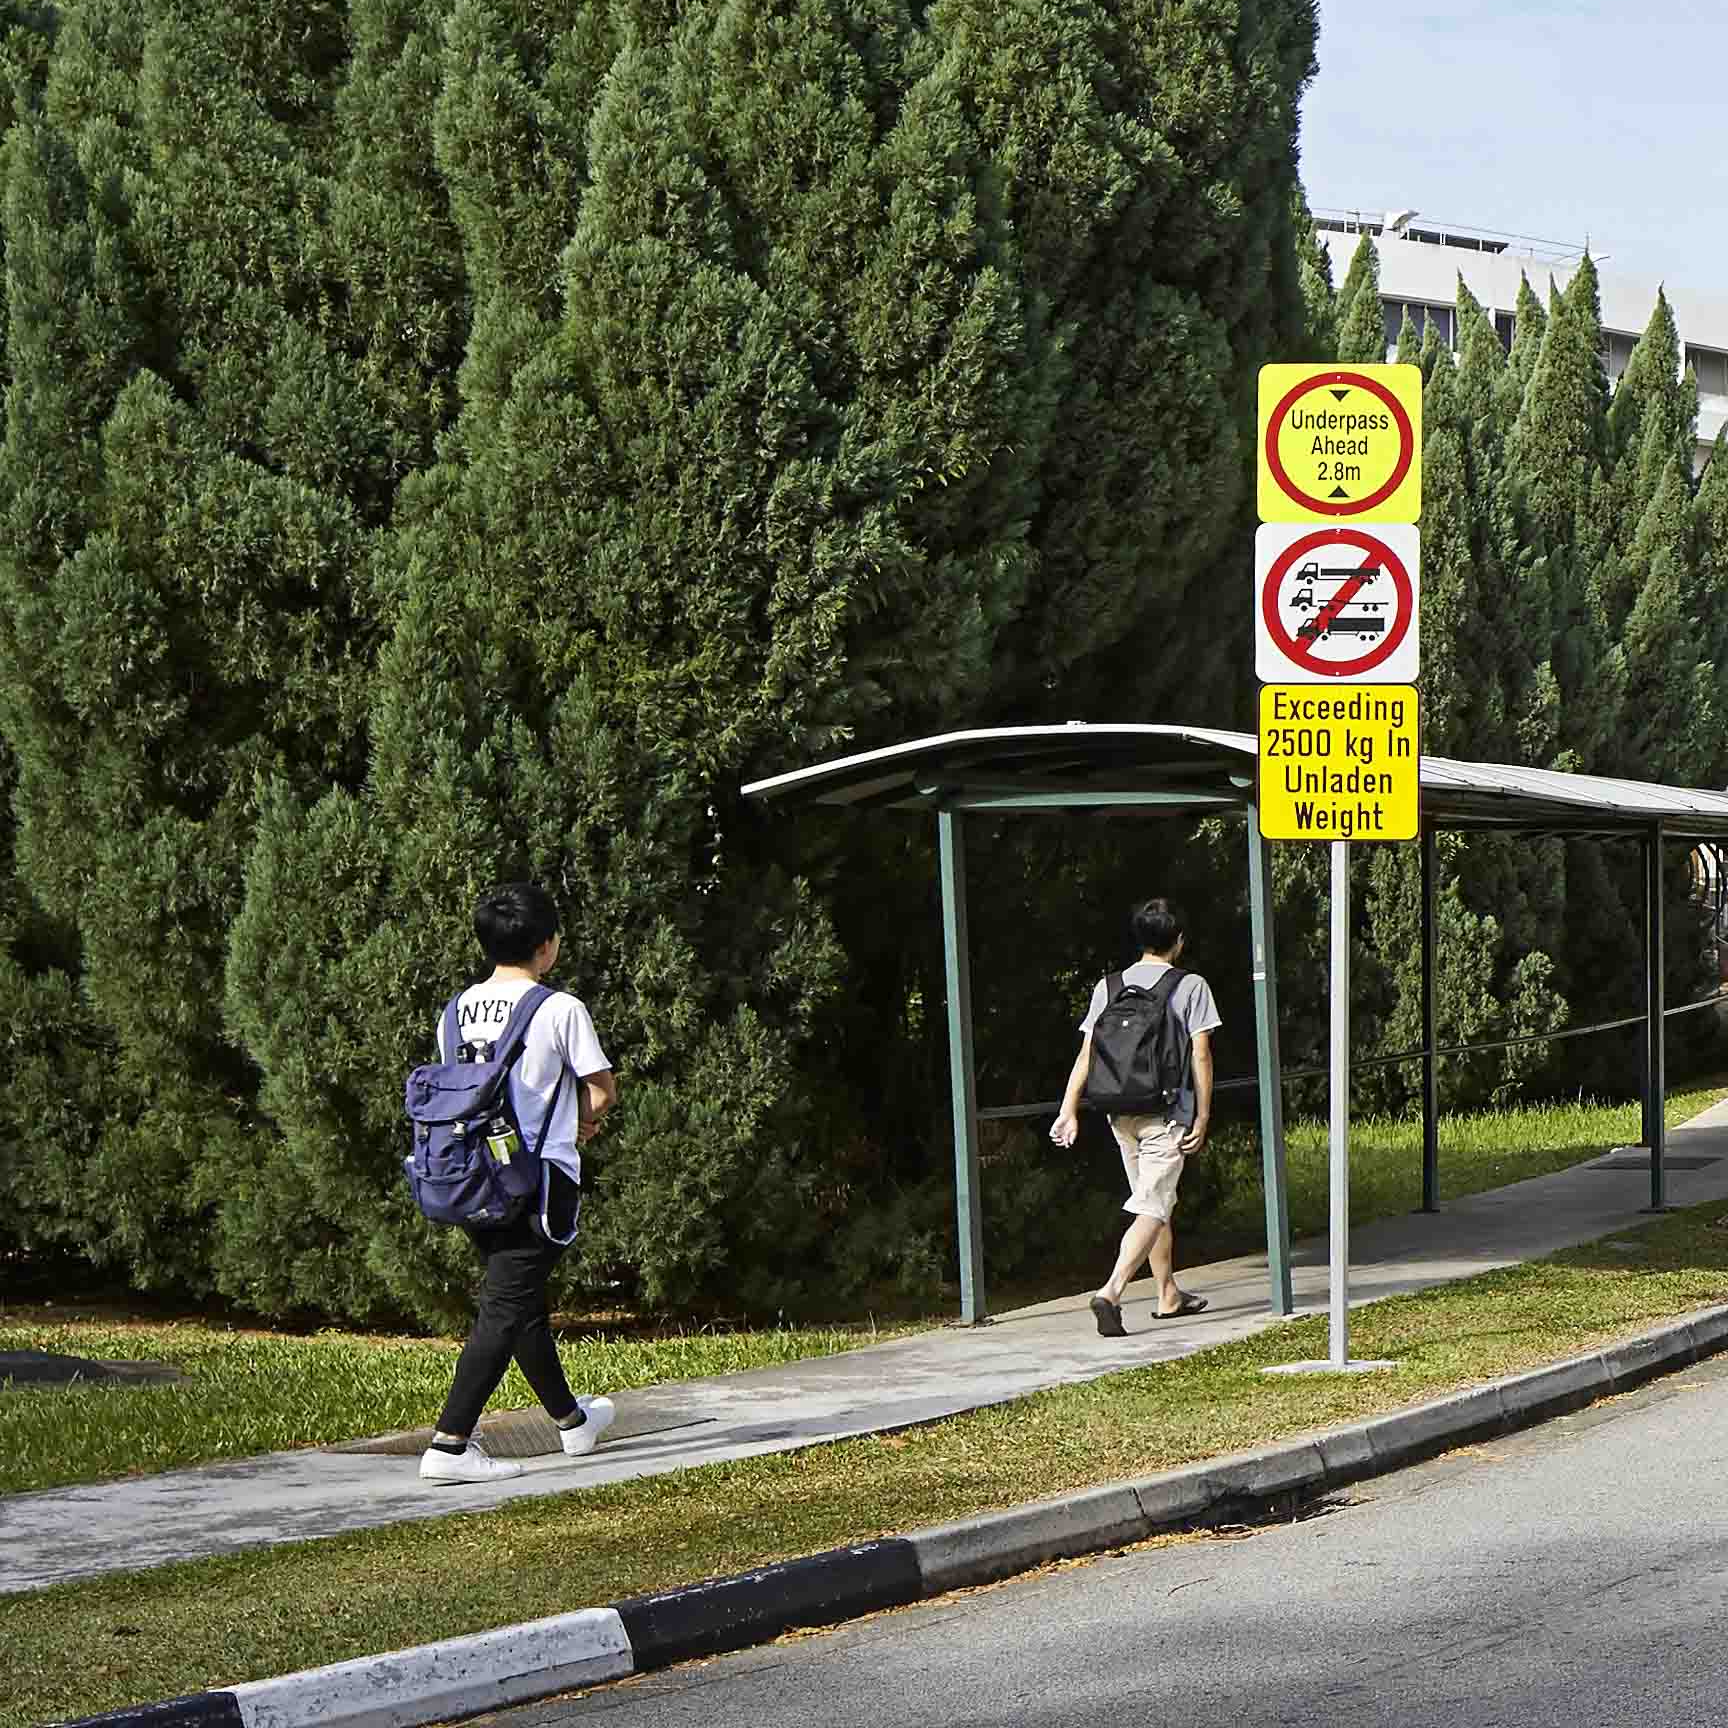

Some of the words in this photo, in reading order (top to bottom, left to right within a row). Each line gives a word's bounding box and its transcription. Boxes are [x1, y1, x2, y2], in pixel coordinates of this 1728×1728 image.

[1290, 409, 1390, 434] Underpass
[1310, 434, 1369, 456] Ahead
[1317, 461, 1361, 482] 2.8m
[1273, 692, 1405, 726] Exceeding
[1267, 728, 1331, 758] 2500
[1345, 728, 1374, 765] kg
[1388, 728, 1411, 758] In
[1285, 764, 1393, 795] Unladen
[1294, 801, 1384, 838] Weight
